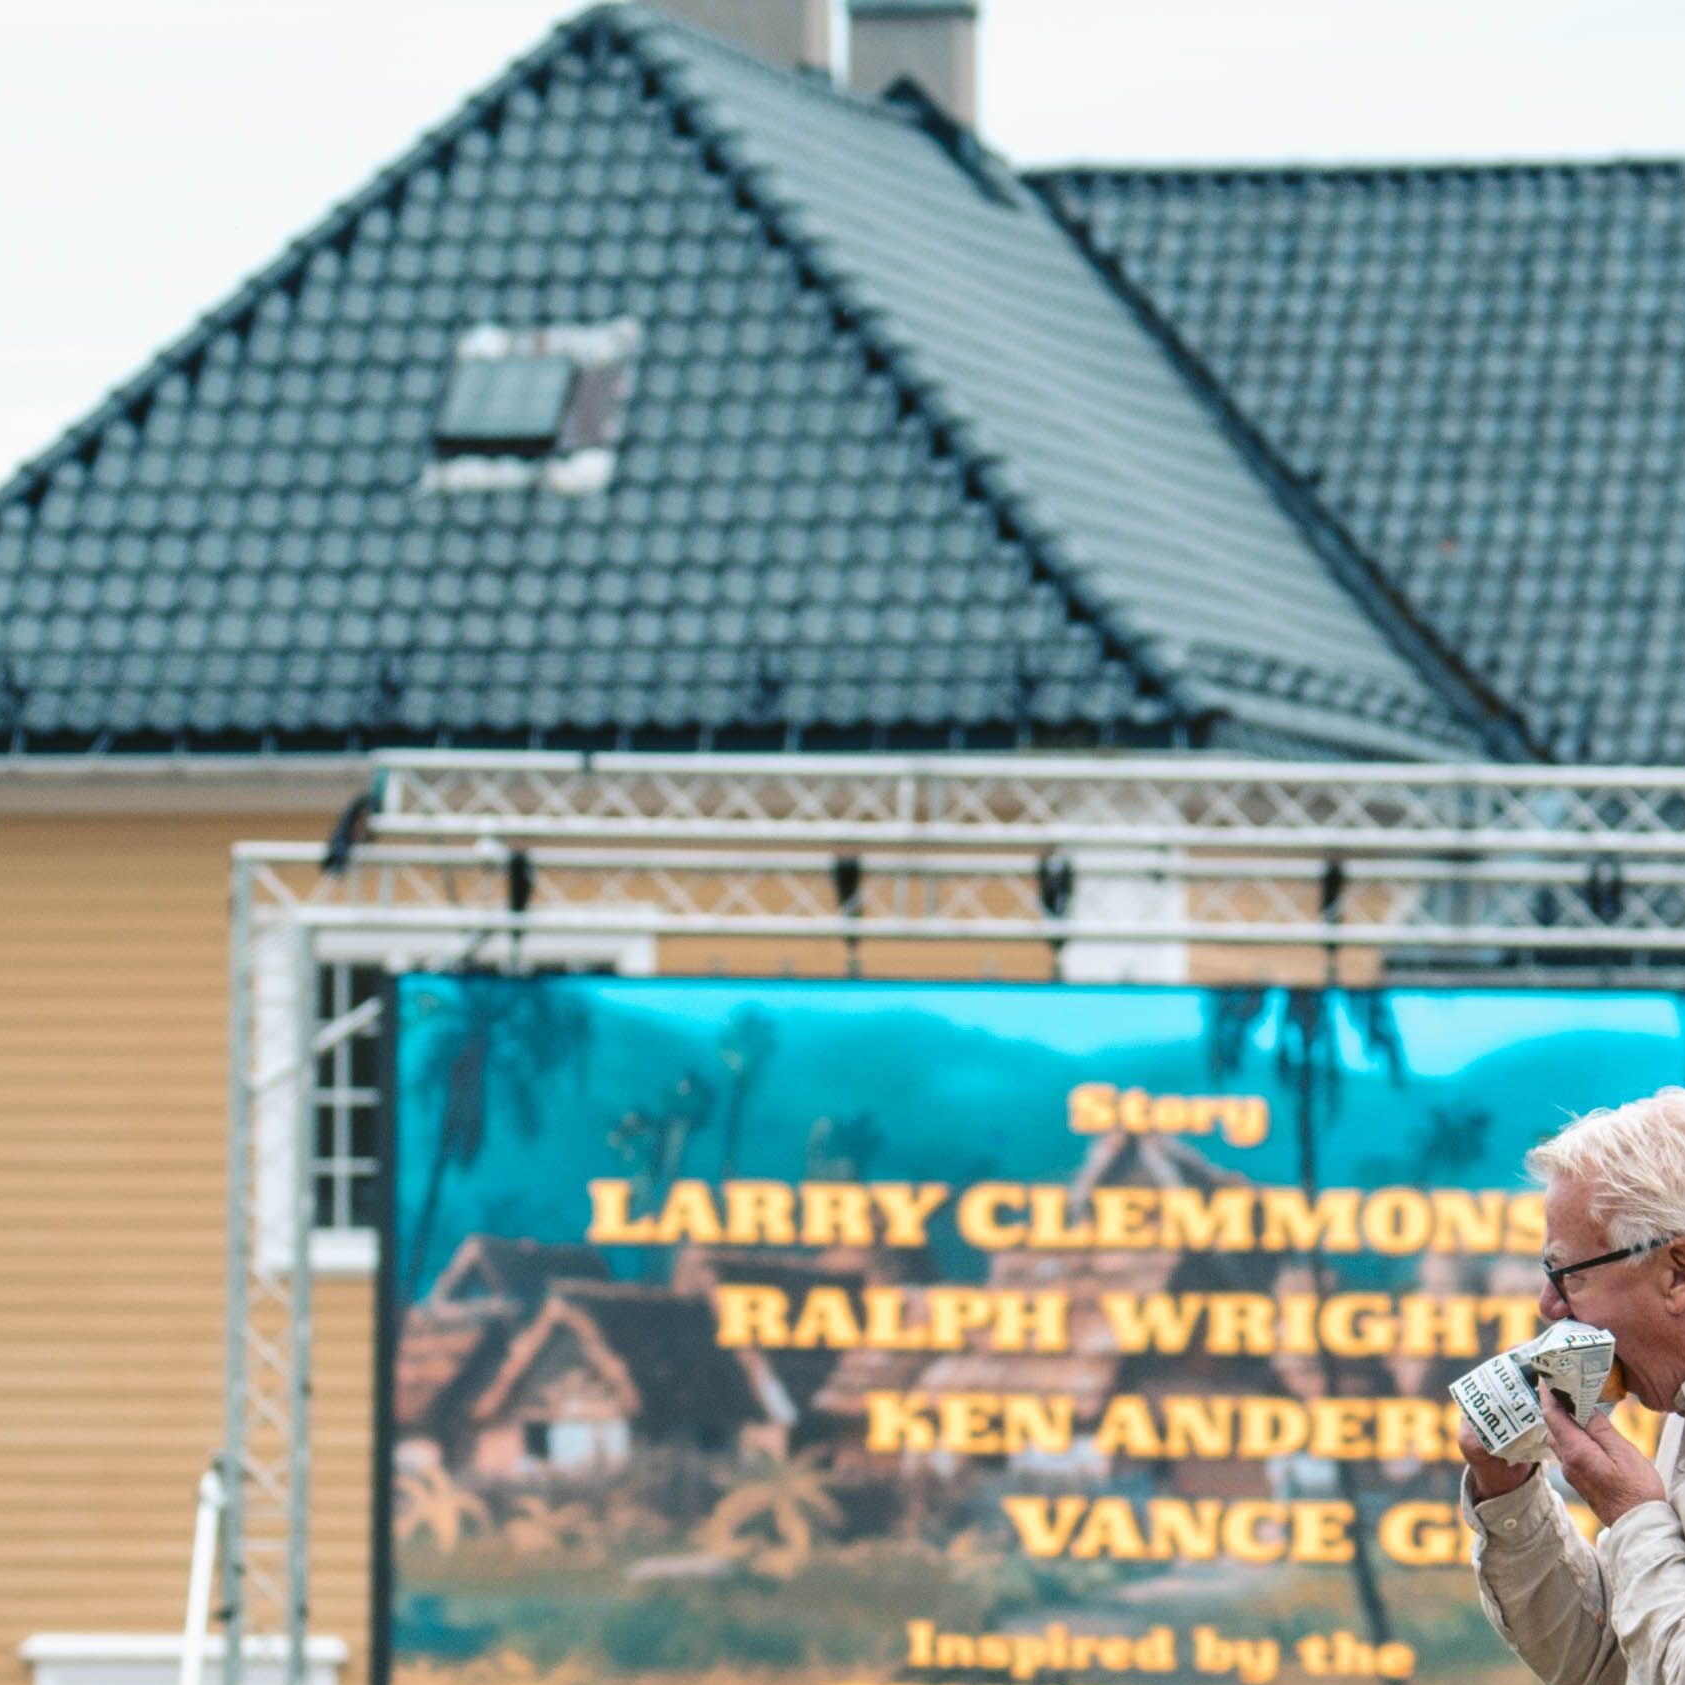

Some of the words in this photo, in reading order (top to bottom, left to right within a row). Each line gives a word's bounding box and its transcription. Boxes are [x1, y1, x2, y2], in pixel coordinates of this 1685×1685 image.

[1067, 1082, 1268, 1146] Story
[587, 1179, 950, 1248] LARRY
[957, 1182, 1546, 1254] CLEMMONS
[717, 1284, 1069, 1350] RALPH
[1103, 1291, 1541, 1357] WRIGHT
[866, 1391, 1073, 1454] KEN
[1003, 1496, 1357, 1563] VANCE
[906, 1619, 1176, 1679] Inspired
[1193, 1626, 1280, 1684] by
[1297, 1631, 1416, 1678] the
